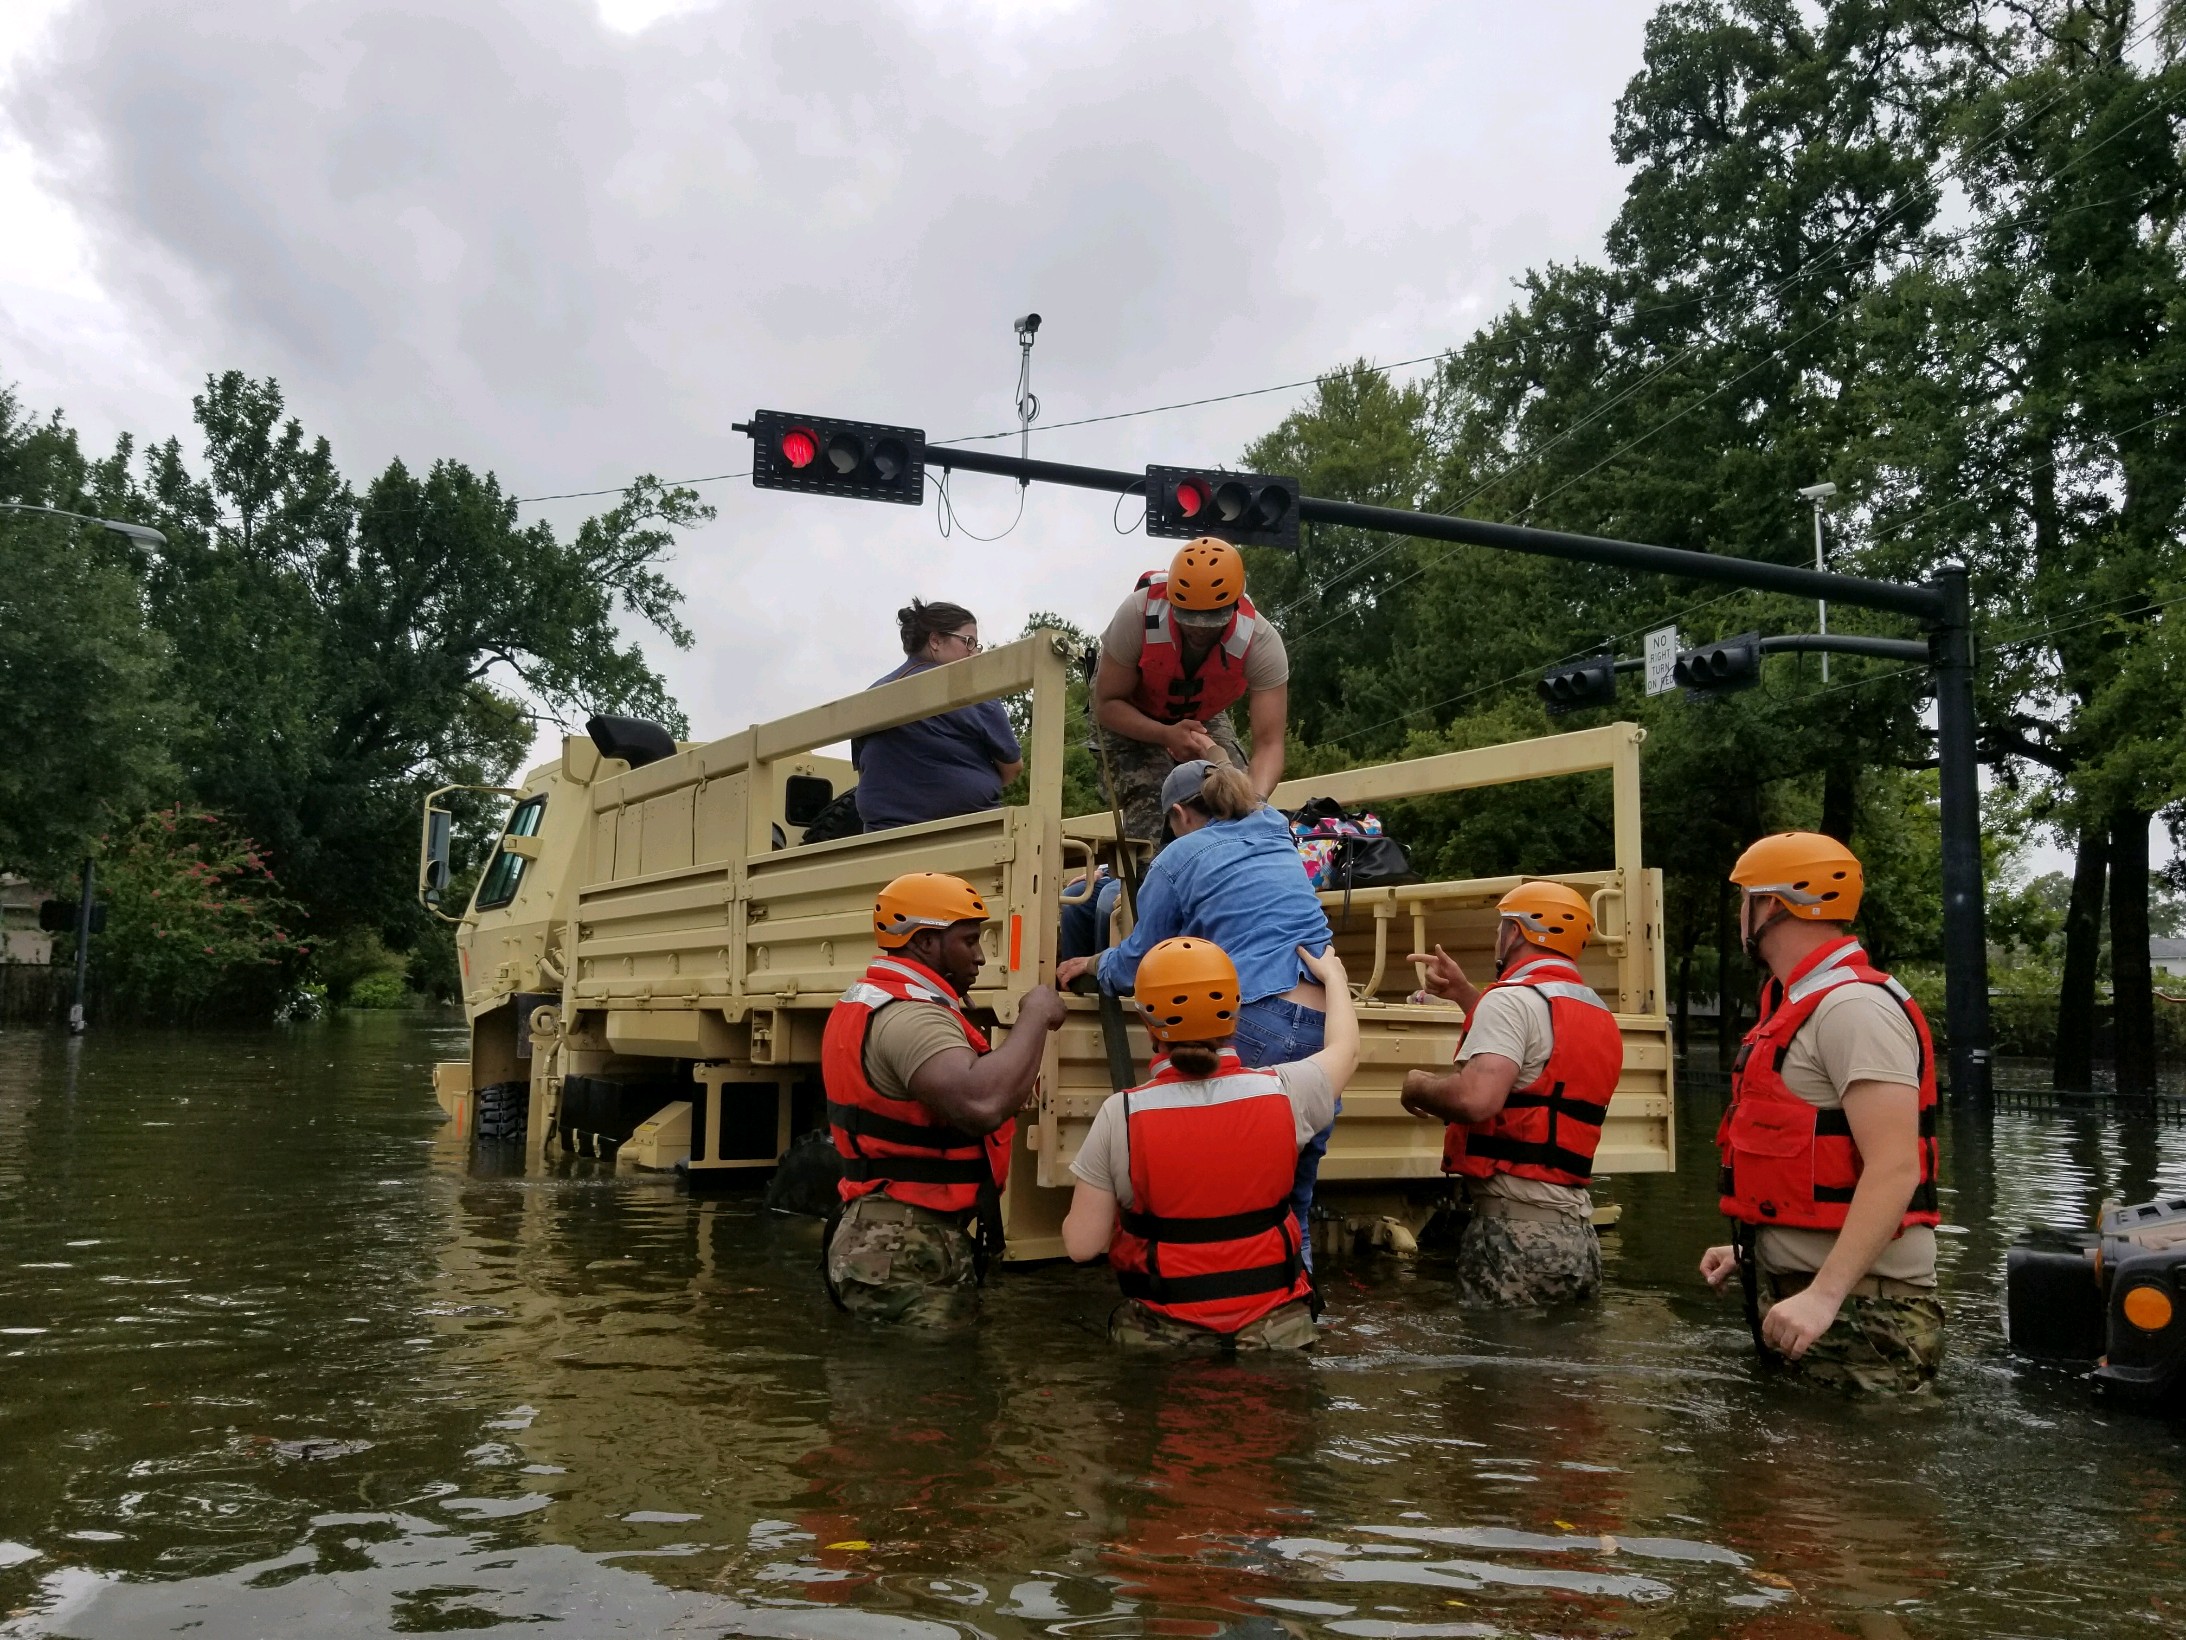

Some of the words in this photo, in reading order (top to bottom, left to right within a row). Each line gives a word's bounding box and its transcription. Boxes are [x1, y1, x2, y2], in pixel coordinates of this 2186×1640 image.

[1653, 635, 1667, 649] NO
[1650, 649, 1671, 663] RIGHT
[1652, 662, 1670, 676] TURN
[1648, 679, 1657, 690] ON
[1661, 674, 1674, 686] RED
